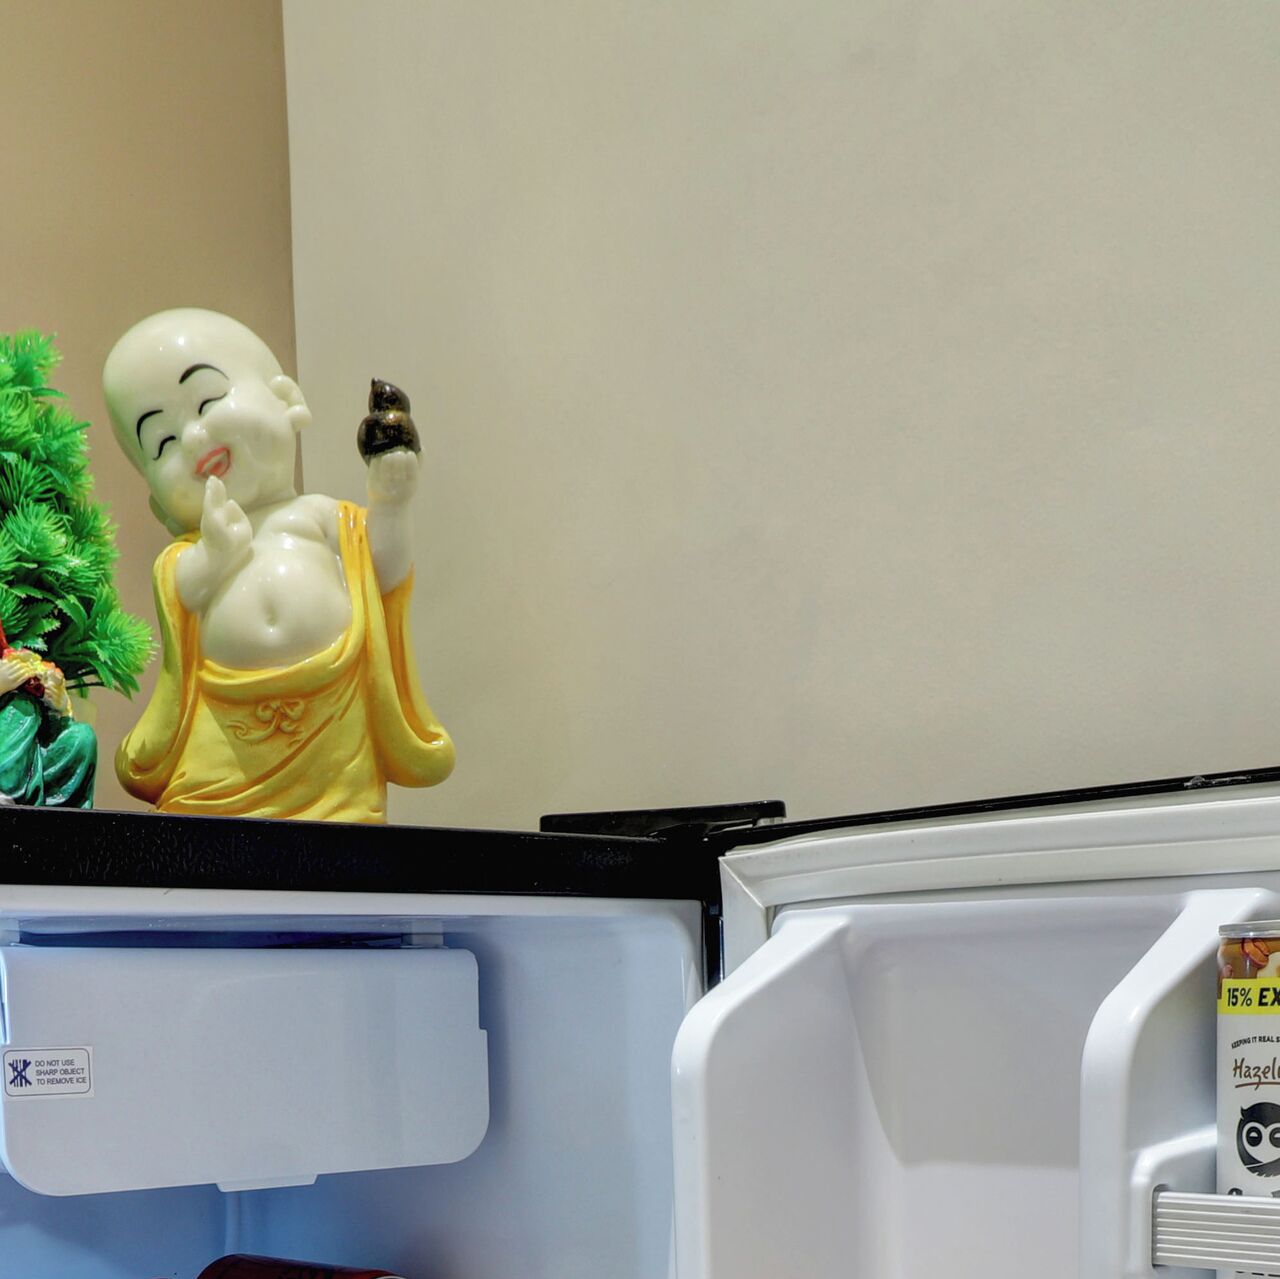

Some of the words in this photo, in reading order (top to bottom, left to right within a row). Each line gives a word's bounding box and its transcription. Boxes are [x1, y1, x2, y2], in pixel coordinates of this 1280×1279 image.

[1227, 987, 1253, 1007] 15%
[35, 1068, 58, 1076] SHARP
[47, 1077, 75, 1085] REMOVE
